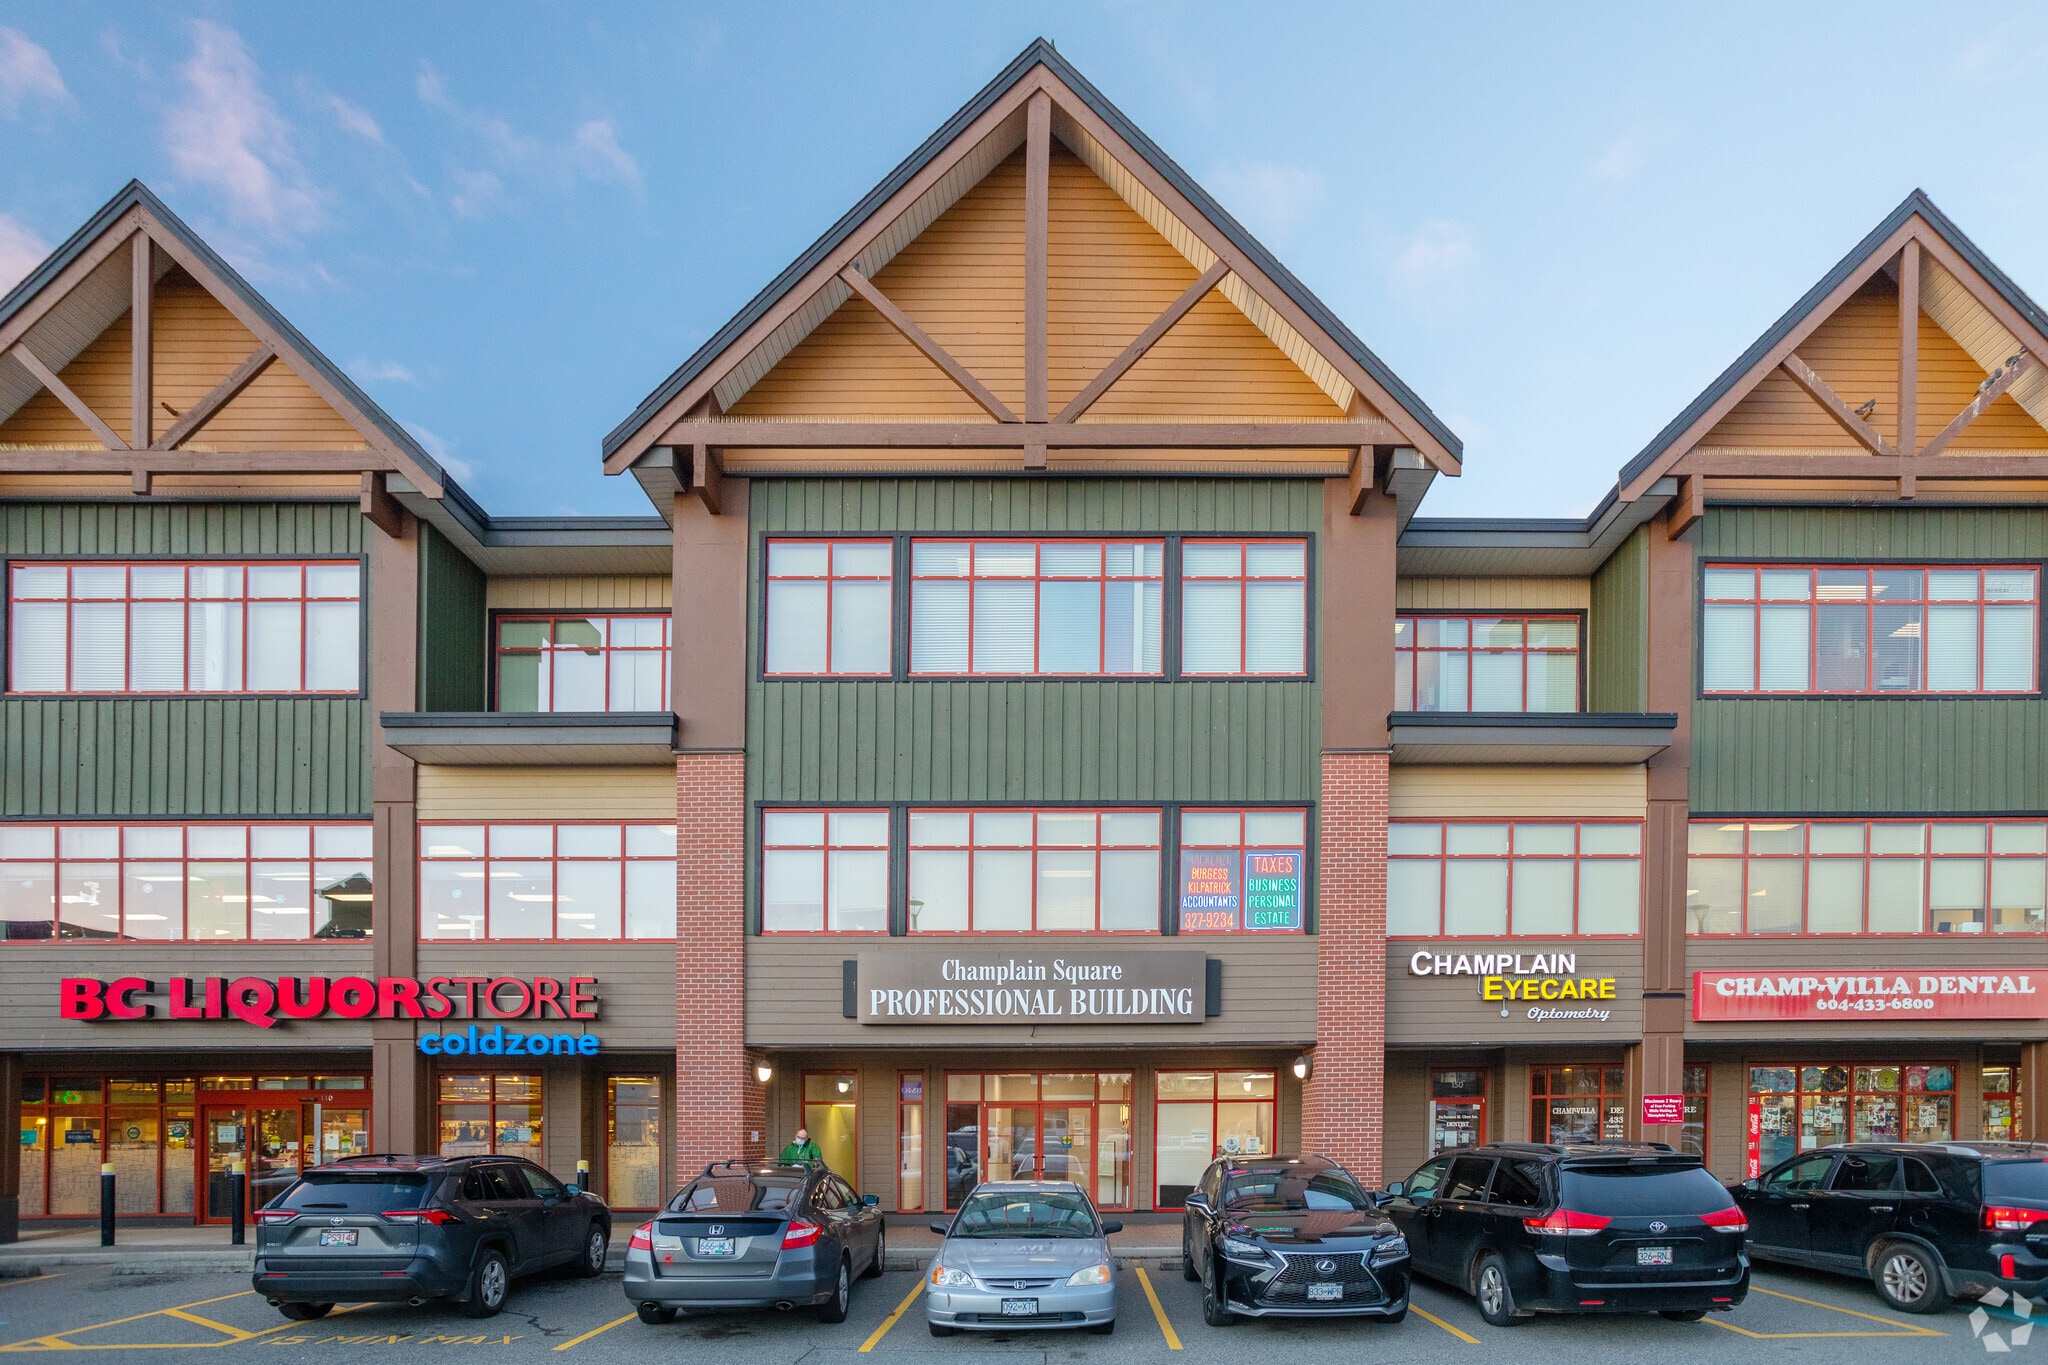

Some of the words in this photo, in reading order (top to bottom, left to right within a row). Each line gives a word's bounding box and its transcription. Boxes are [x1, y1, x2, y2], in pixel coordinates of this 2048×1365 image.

[1254, 856, 1293, 873] TAXES
[1191, 868, 1228, 880] BURGESS
[1188, 882, 1232, 894] KILPATRICK
[1248, 878, 1297, 892] BUSINESS
[1182, 895, 1238, 908] ACCOUNTANTS
[1248, 894, 1296, 909] PERSONAL
[1184, 912, 1235, 929] 327-9234
[1254, 911, 1290, 925] ESTATE
[1410, 951, 1576, 976] CHAMPLAIN
[942, 958, 1046, 985] Champlain
[1053, 959, 1123, 985] Square
[1483, 976, 1617, 1001] EYECARE
[1716, 976, 1912, 996] CHAMP-VILLA
[1918, 975, 2036, 995] DENTAL
[60, 977, 153, 1019] BC
[869, 988, 1062, 1017] PROFESSIONAL
[1069, 988, 1194, 1016] BUILDING
[1816, 998, 1935, 1012] 604-433-6800
[1527, 1006, 1611, 1022] Optometry
[419, 1025, 601, 1056] coldzone
[1451, 1081, 1464, 1089] 150
[321, 1094, 334, 1102] 110
[1608, 1116, 1624, 1124] 433
[314, 1335, 414, 1345] MIN
[418, 1335, 525, 1345] MAX
